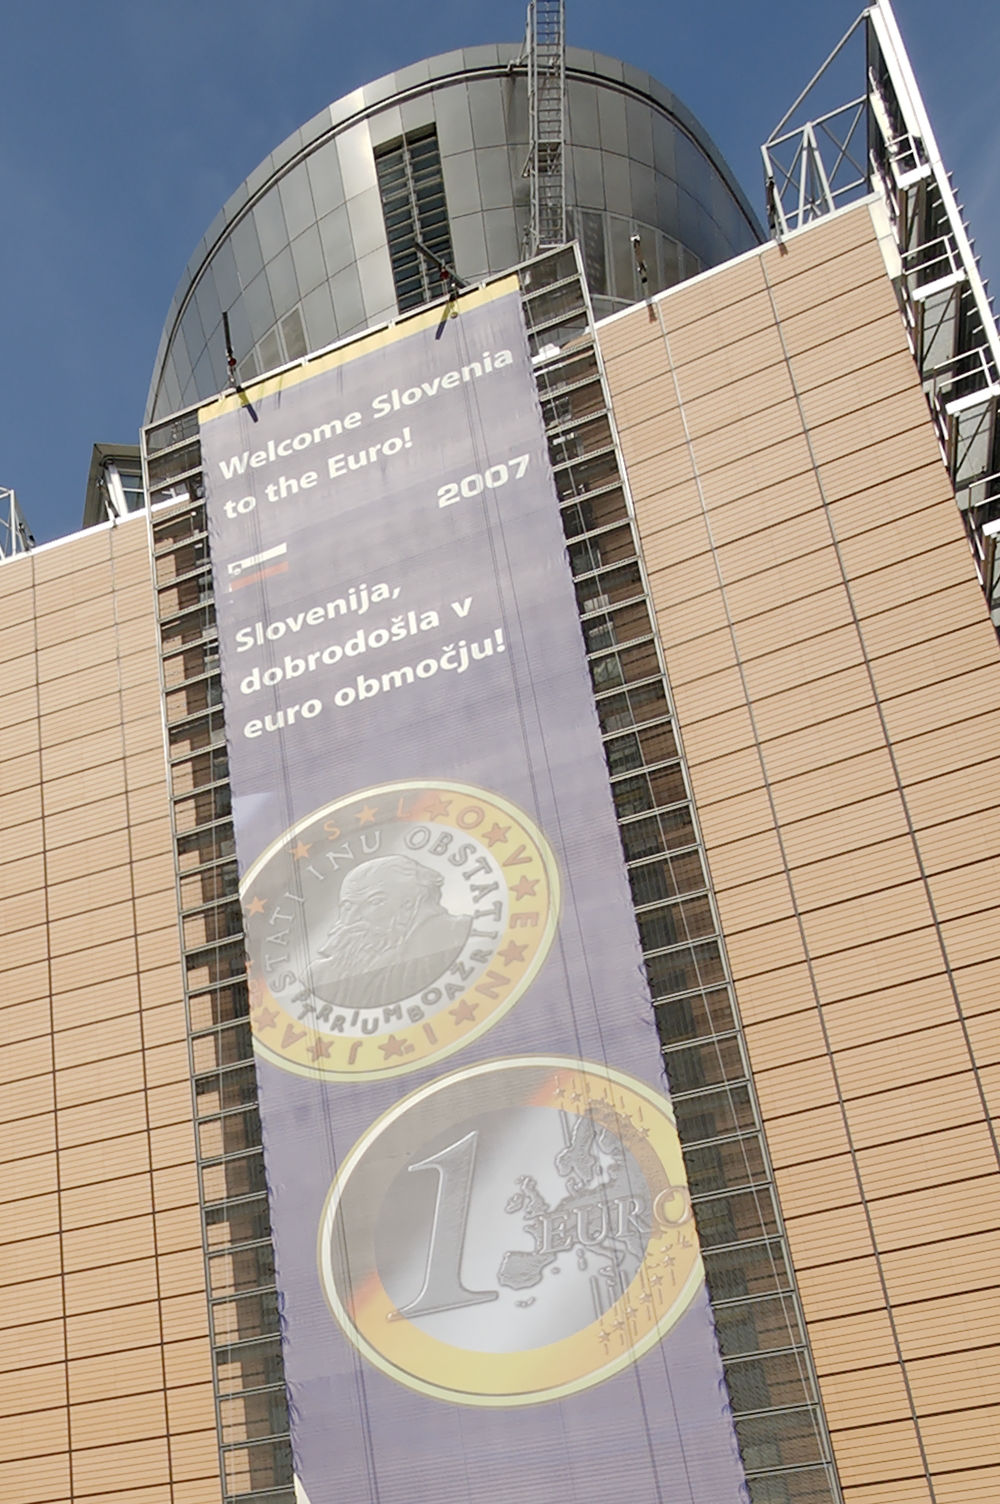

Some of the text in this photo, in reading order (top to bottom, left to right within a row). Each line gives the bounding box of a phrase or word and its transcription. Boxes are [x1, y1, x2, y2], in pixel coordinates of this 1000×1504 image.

[218, 349, 514, 480] Welcome Slovenia
[223, 427, 413, 519] to the Euro!
[437, 453, 531, 509] 2007
[235, 581, 401, 653] Slovenija,
[239, 596, 473, 696] dobrodošla v
[243, 628, 507, 739] euro območju!
[387, 1131, 693, 1322] 1 EURO
